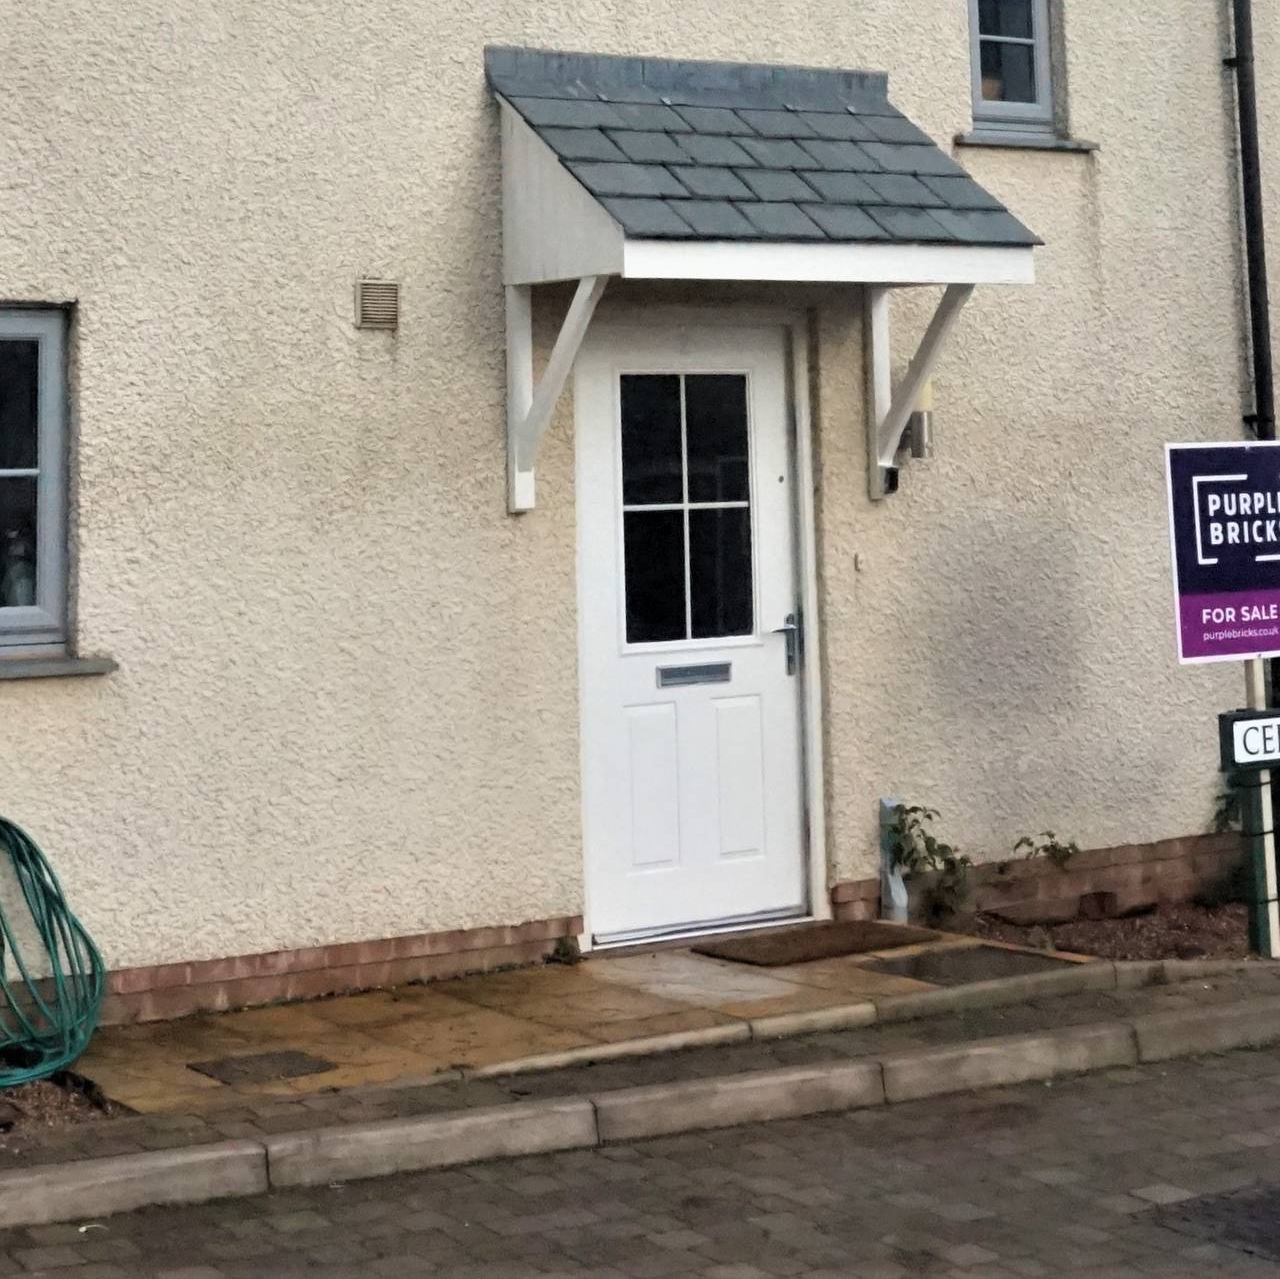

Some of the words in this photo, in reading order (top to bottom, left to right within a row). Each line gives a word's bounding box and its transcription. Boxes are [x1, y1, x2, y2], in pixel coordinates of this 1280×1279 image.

[1202, 607, 1236, 624] FOR
[1240, 604, 1278, 622] SALE
[1203, 626, 1279, 641] purplebricks.co.uk
